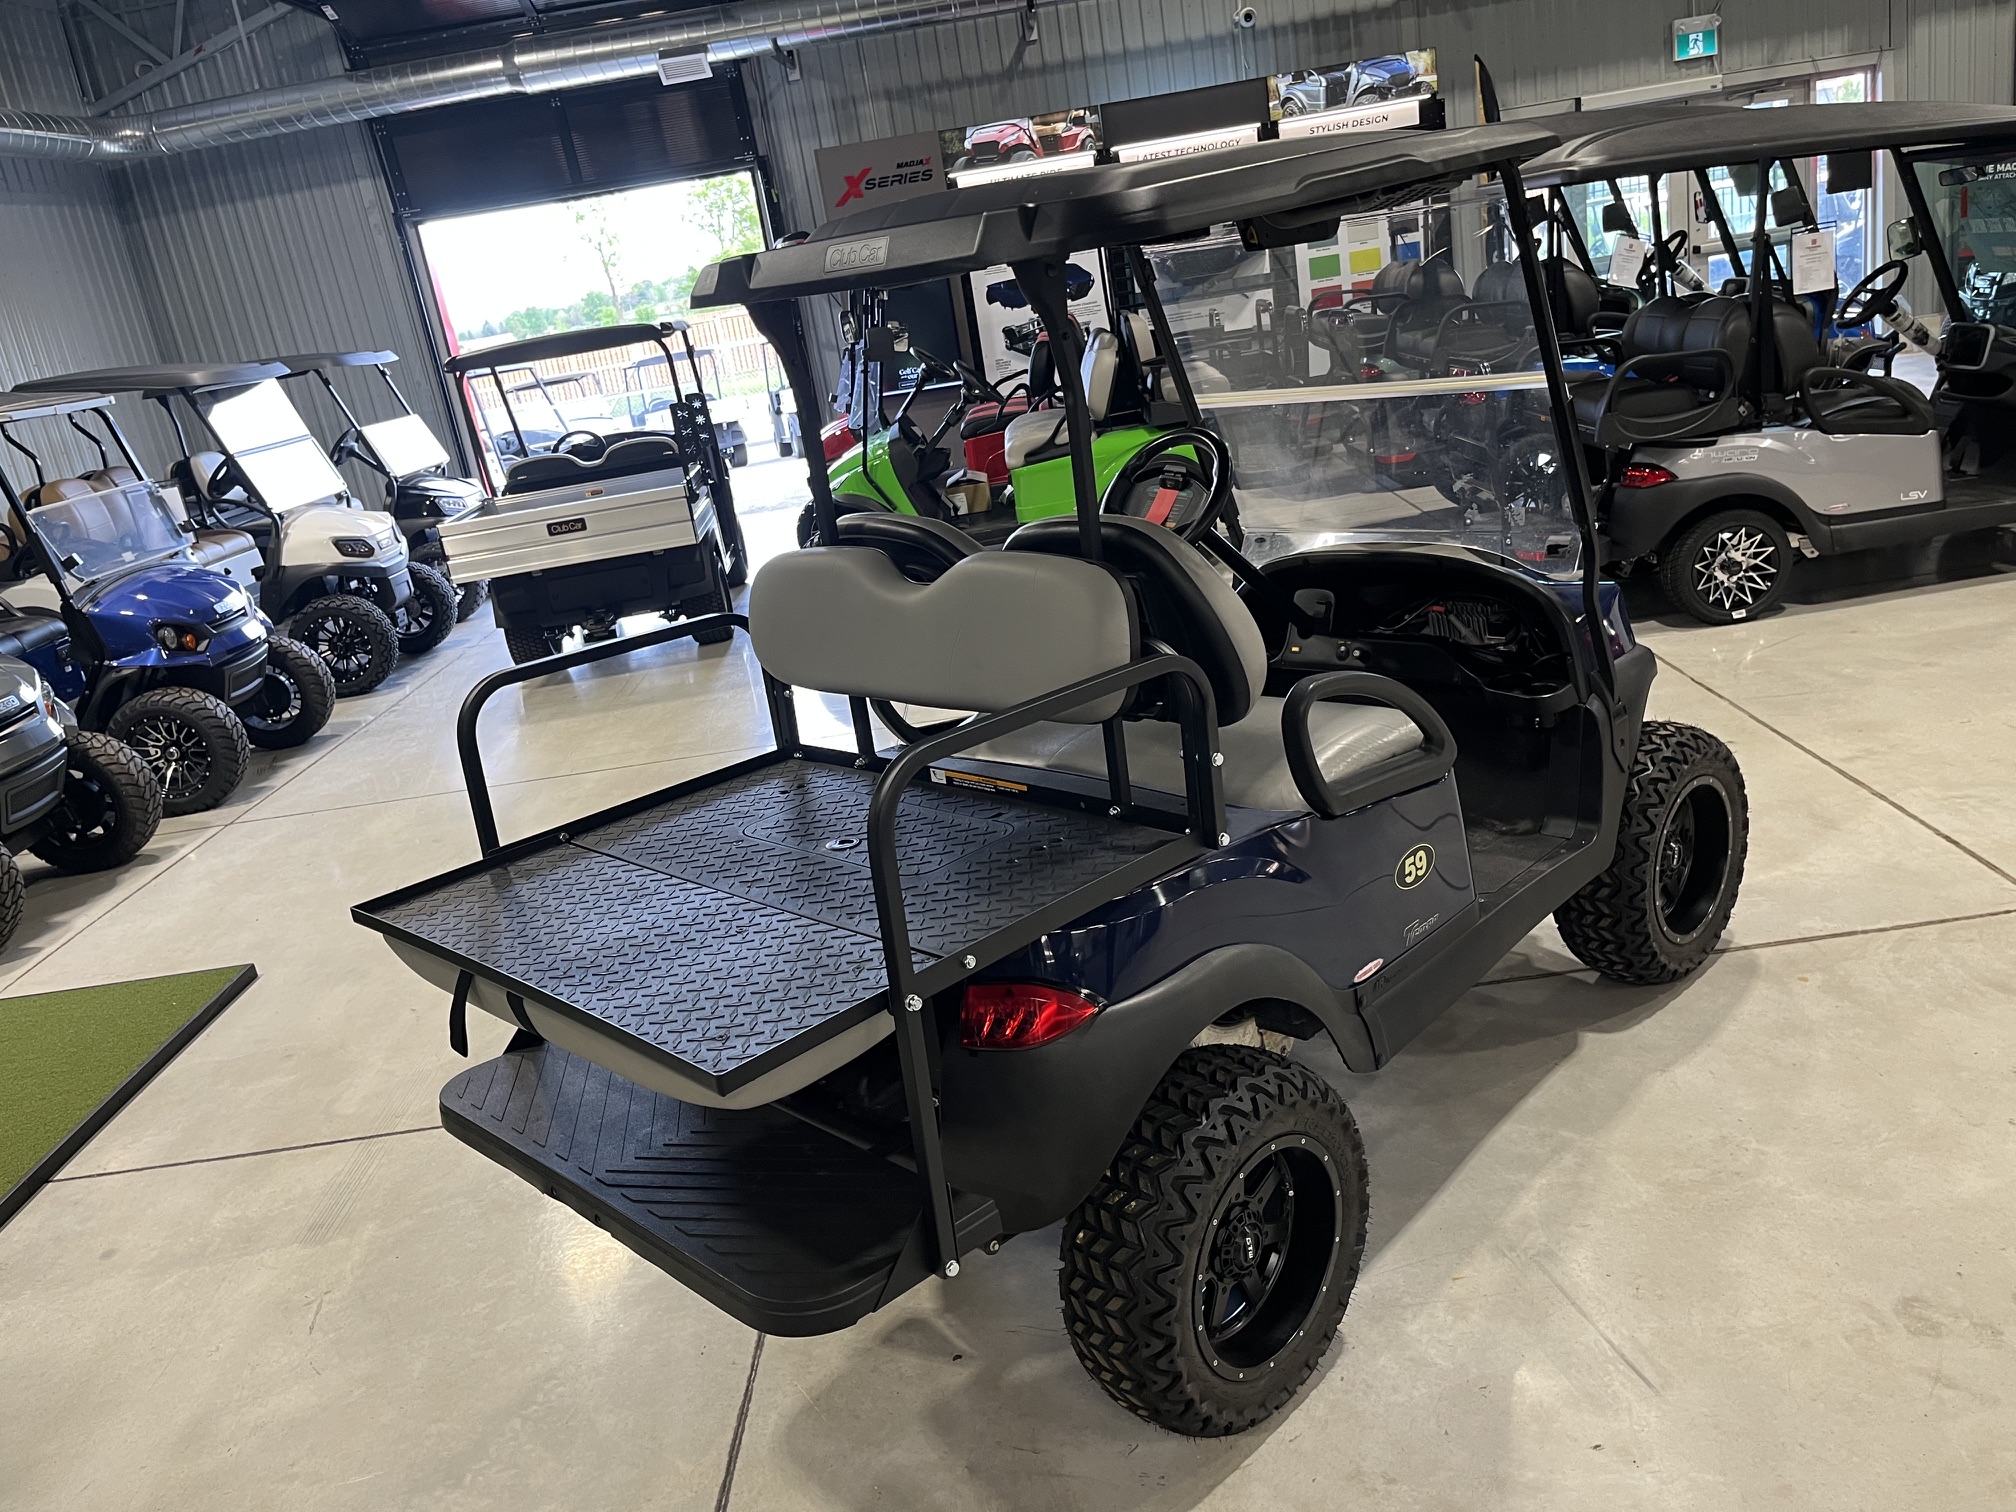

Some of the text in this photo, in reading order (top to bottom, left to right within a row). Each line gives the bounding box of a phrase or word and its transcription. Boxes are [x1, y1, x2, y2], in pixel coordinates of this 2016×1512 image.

[1309, 114, 1389, 135] STYLISH DESIGN
[1136, 138, 1242, 162] LATEST TECHNOLOGY
[896, 156, 932, 170] MADJAX
[829, 243, 883, 269] Club Car
[1900, 489, 1928, 501] LSV
[551, 522, 583, 534] Club Car
[1404, 849, 1428, 884] 59
